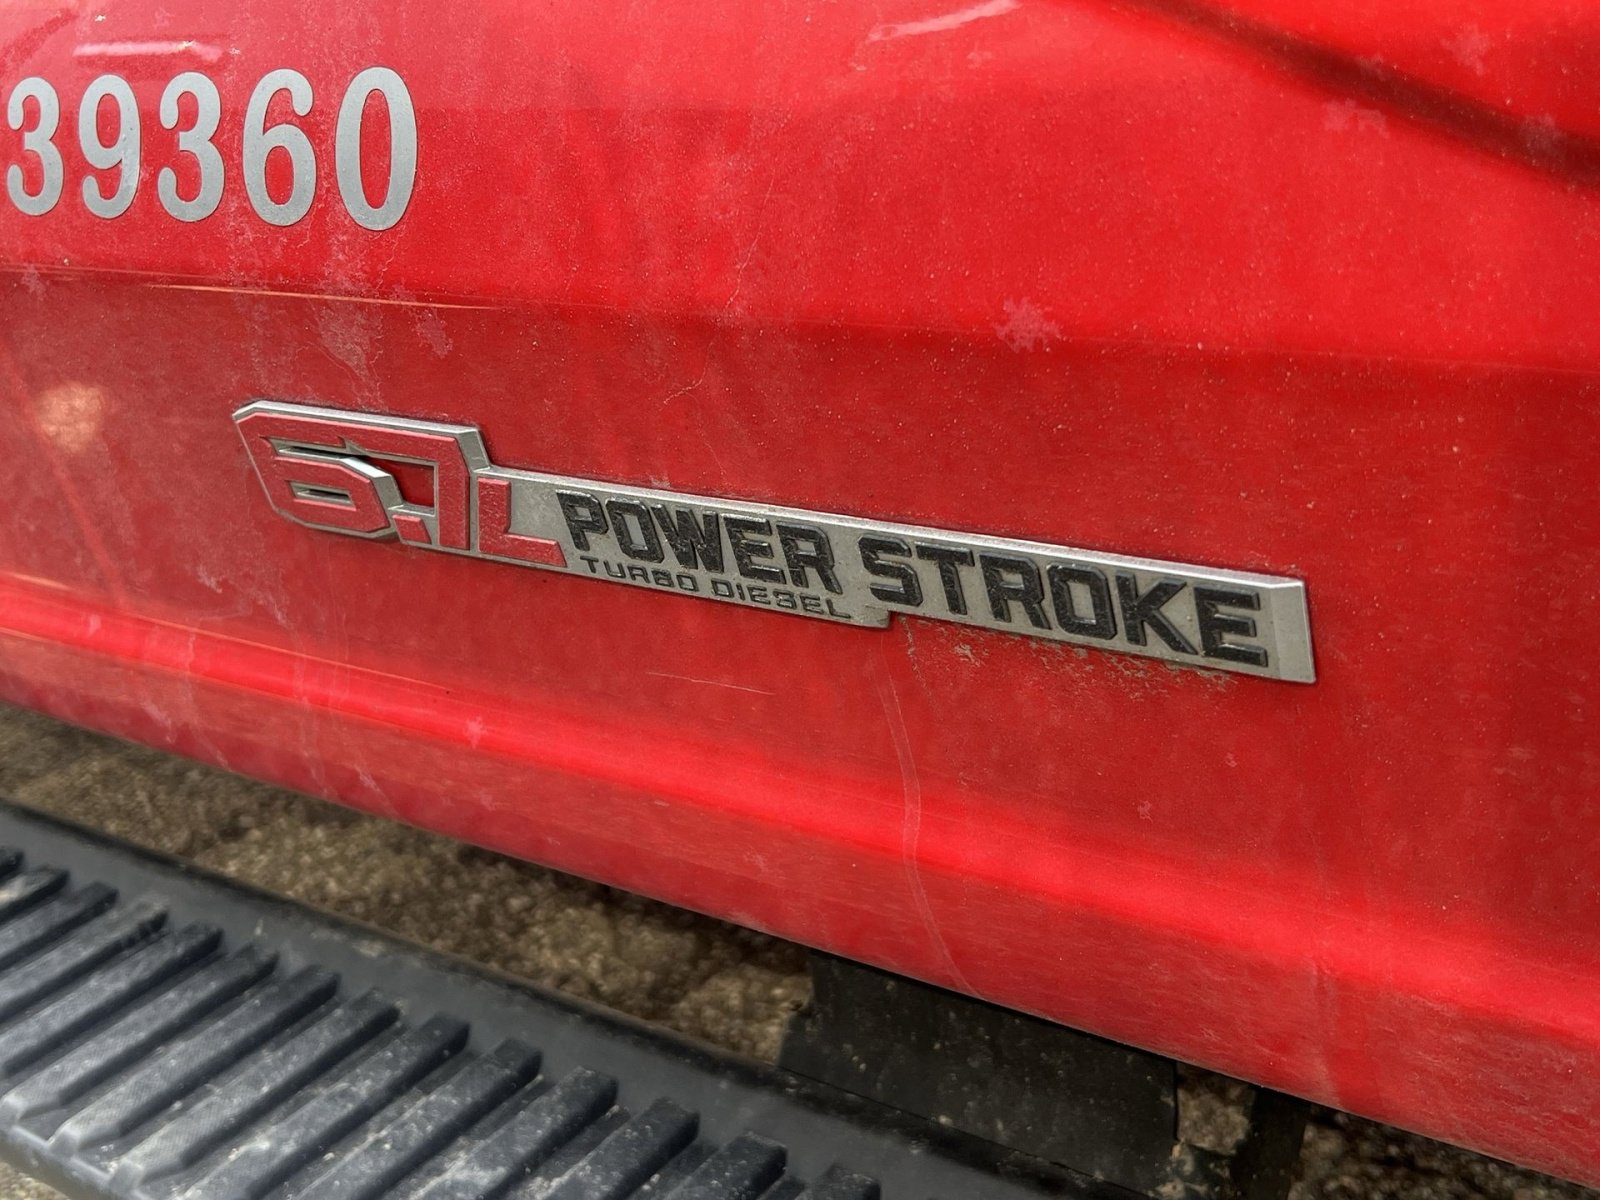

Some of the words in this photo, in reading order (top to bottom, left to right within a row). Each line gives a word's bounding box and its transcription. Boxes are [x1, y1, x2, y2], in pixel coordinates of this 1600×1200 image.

[7, 66, 418, 231] 39360
[234, 402, 567, 568] 6.7L
[556, 489, 843, 595] POWER
[857, 533, 1269, 668] STROKE
[580, 554, 700, 593] TURBO
[710, 578, 853, 619] DIESEL
